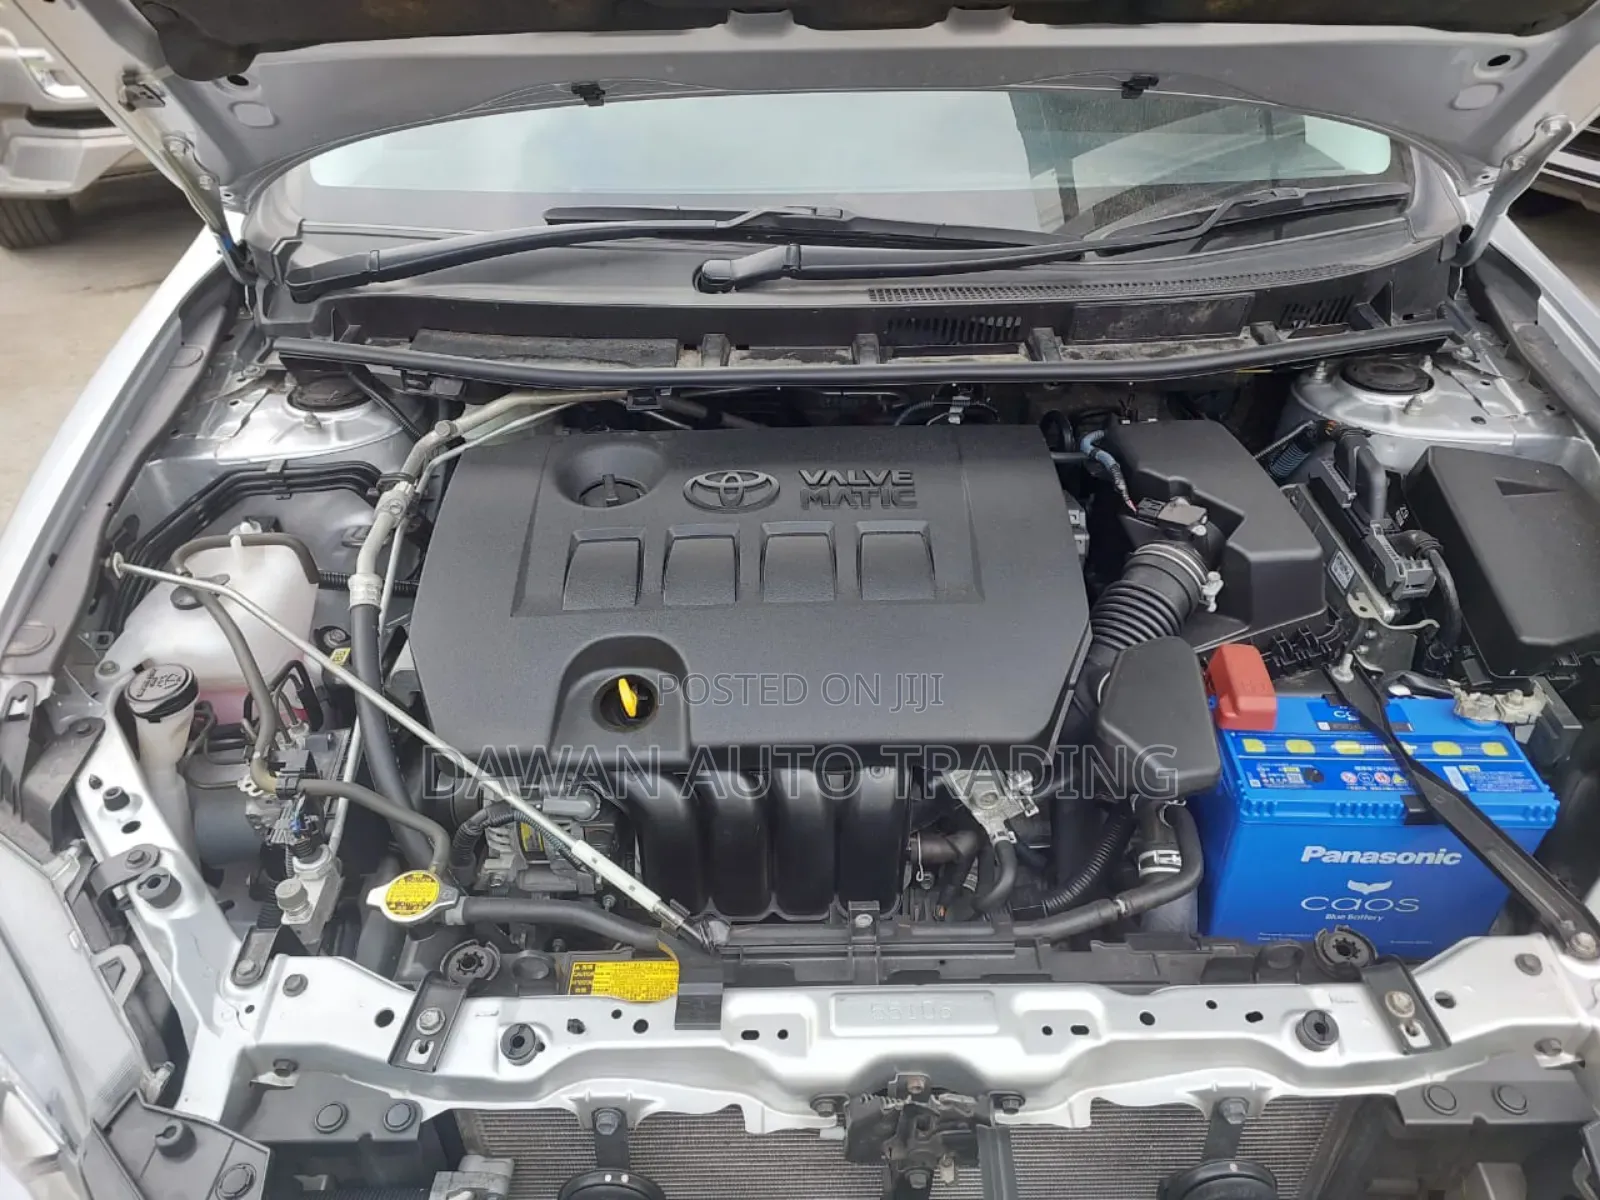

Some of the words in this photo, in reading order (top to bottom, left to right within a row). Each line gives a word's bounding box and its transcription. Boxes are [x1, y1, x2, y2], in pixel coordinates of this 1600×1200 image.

[799, 469, 914, 487] VALVE
[799, 487, 918, 511] MATIC
[1300, 845, 1463, 866] Panasonic
[1300, 896, 1420, 913] caos
[1325, 912, 1347, 921] Blue
[1347, 912, 1385, 922] Battery
